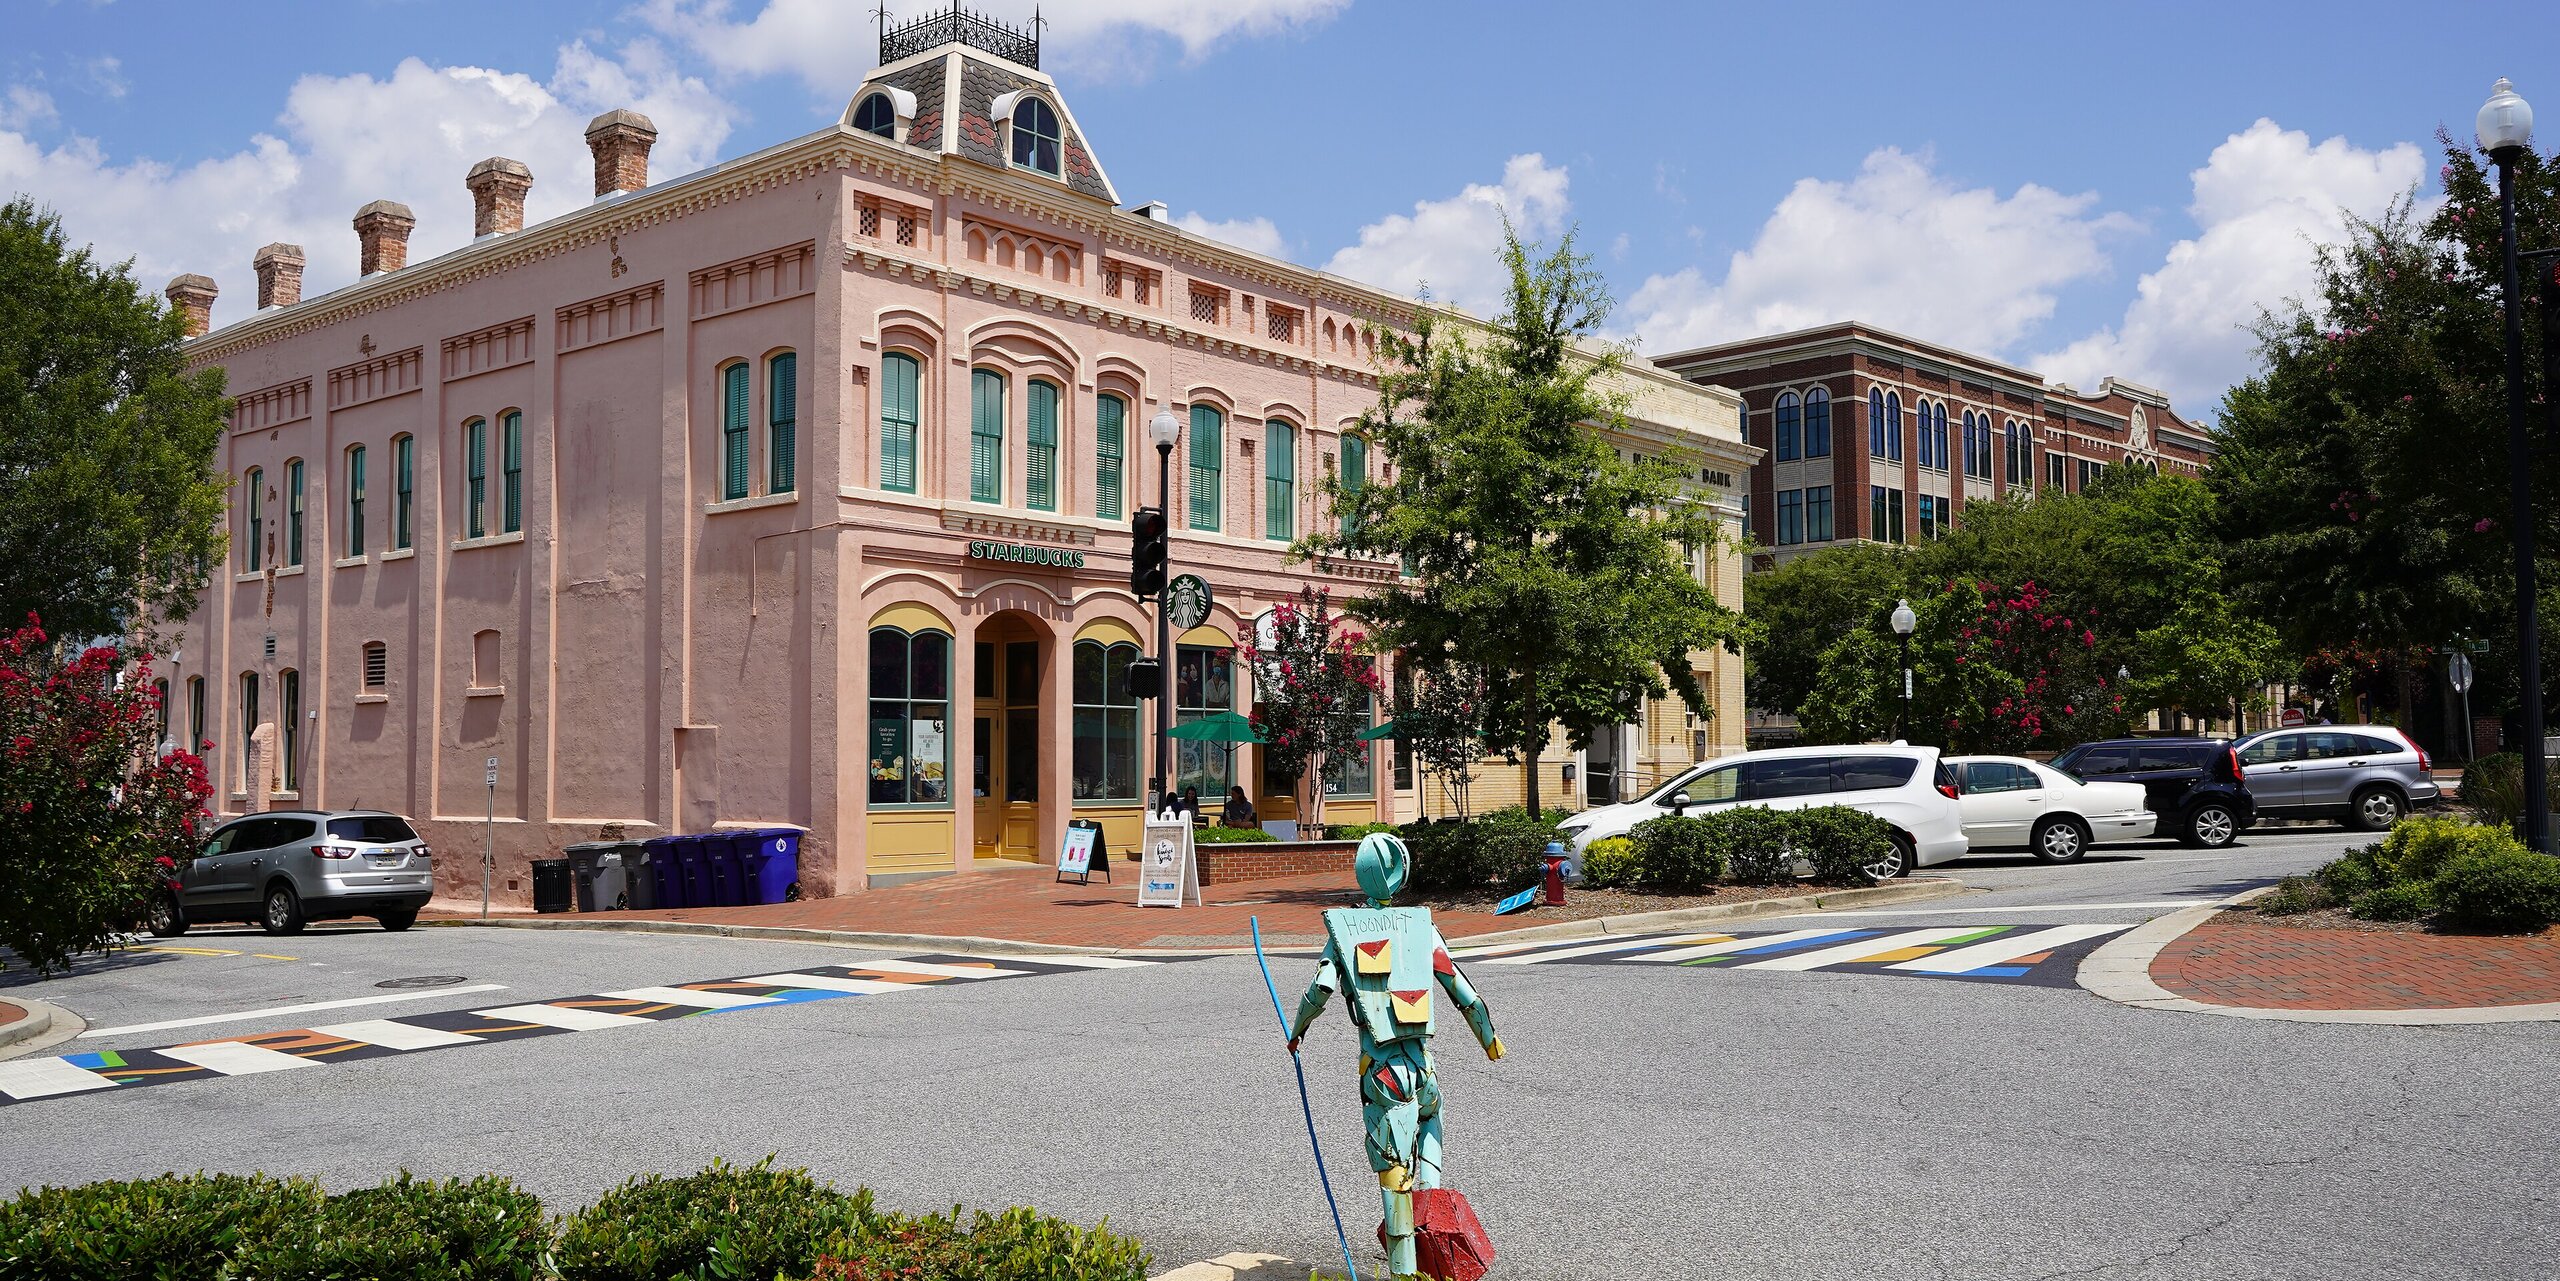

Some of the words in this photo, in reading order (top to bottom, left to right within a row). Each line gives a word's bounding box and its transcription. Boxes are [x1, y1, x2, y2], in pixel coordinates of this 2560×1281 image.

[1702, 468, 1731, 488] BANK
[972, 541, 1085, 568] STARBUCKS
[1326, 783, 1337, 793] 154
